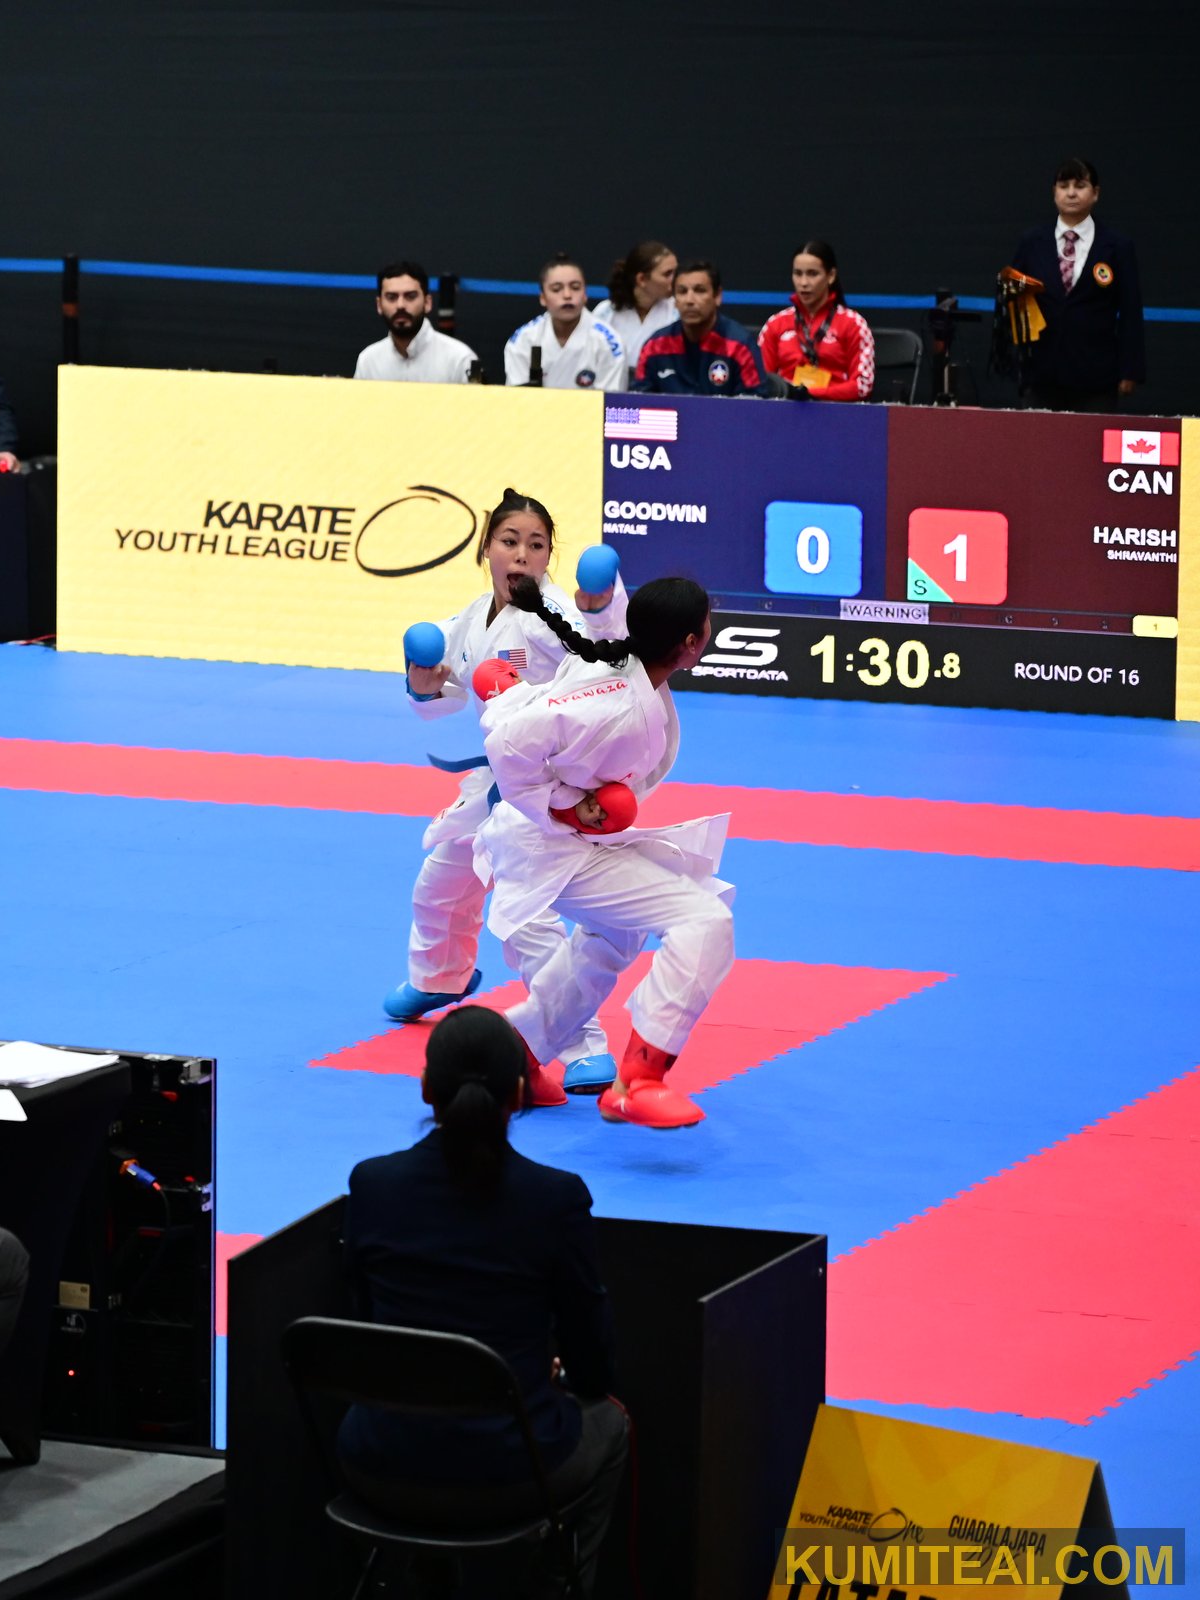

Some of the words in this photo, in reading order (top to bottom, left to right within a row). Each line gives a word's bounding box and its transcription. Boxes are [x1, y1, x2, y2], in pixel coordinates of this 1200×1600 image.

[610, 444, 672, 471] USA
[1107, 468, 1173, 495] CAN
[203, 500, 356, 535] KARATE
[604, 500, 707, 523] GOODWIN
[603, 523, 647, 535] NATALIE
[1093, 526, 1176, 548] HARISH
[115, 528, 219, 554] YOUTH
[225, 536, 351, 562] LEAGUE
[797, 527, 830, 574] 0
[1107, 549, 1177, 563] SHRAVANTHI
[943, 534, 967, 582] 1
[913, 579, 928, 596] S
[848, 604, 922, 620] WARNING
[691, 665, 789, 681] SPORTDATA
[1014, 662, 1082, 683] ROUND
[1087, 667, 1112, 684] OF
[1118, 669, 1140, 686] 16
[548, 681, 628, 707] Arawaza
[800, 1512, 830, 1527] YOUTH
[827, 1505, 873, 1525] KARATE
[948, 1515, 1047, 1557] GUADALAJARA
